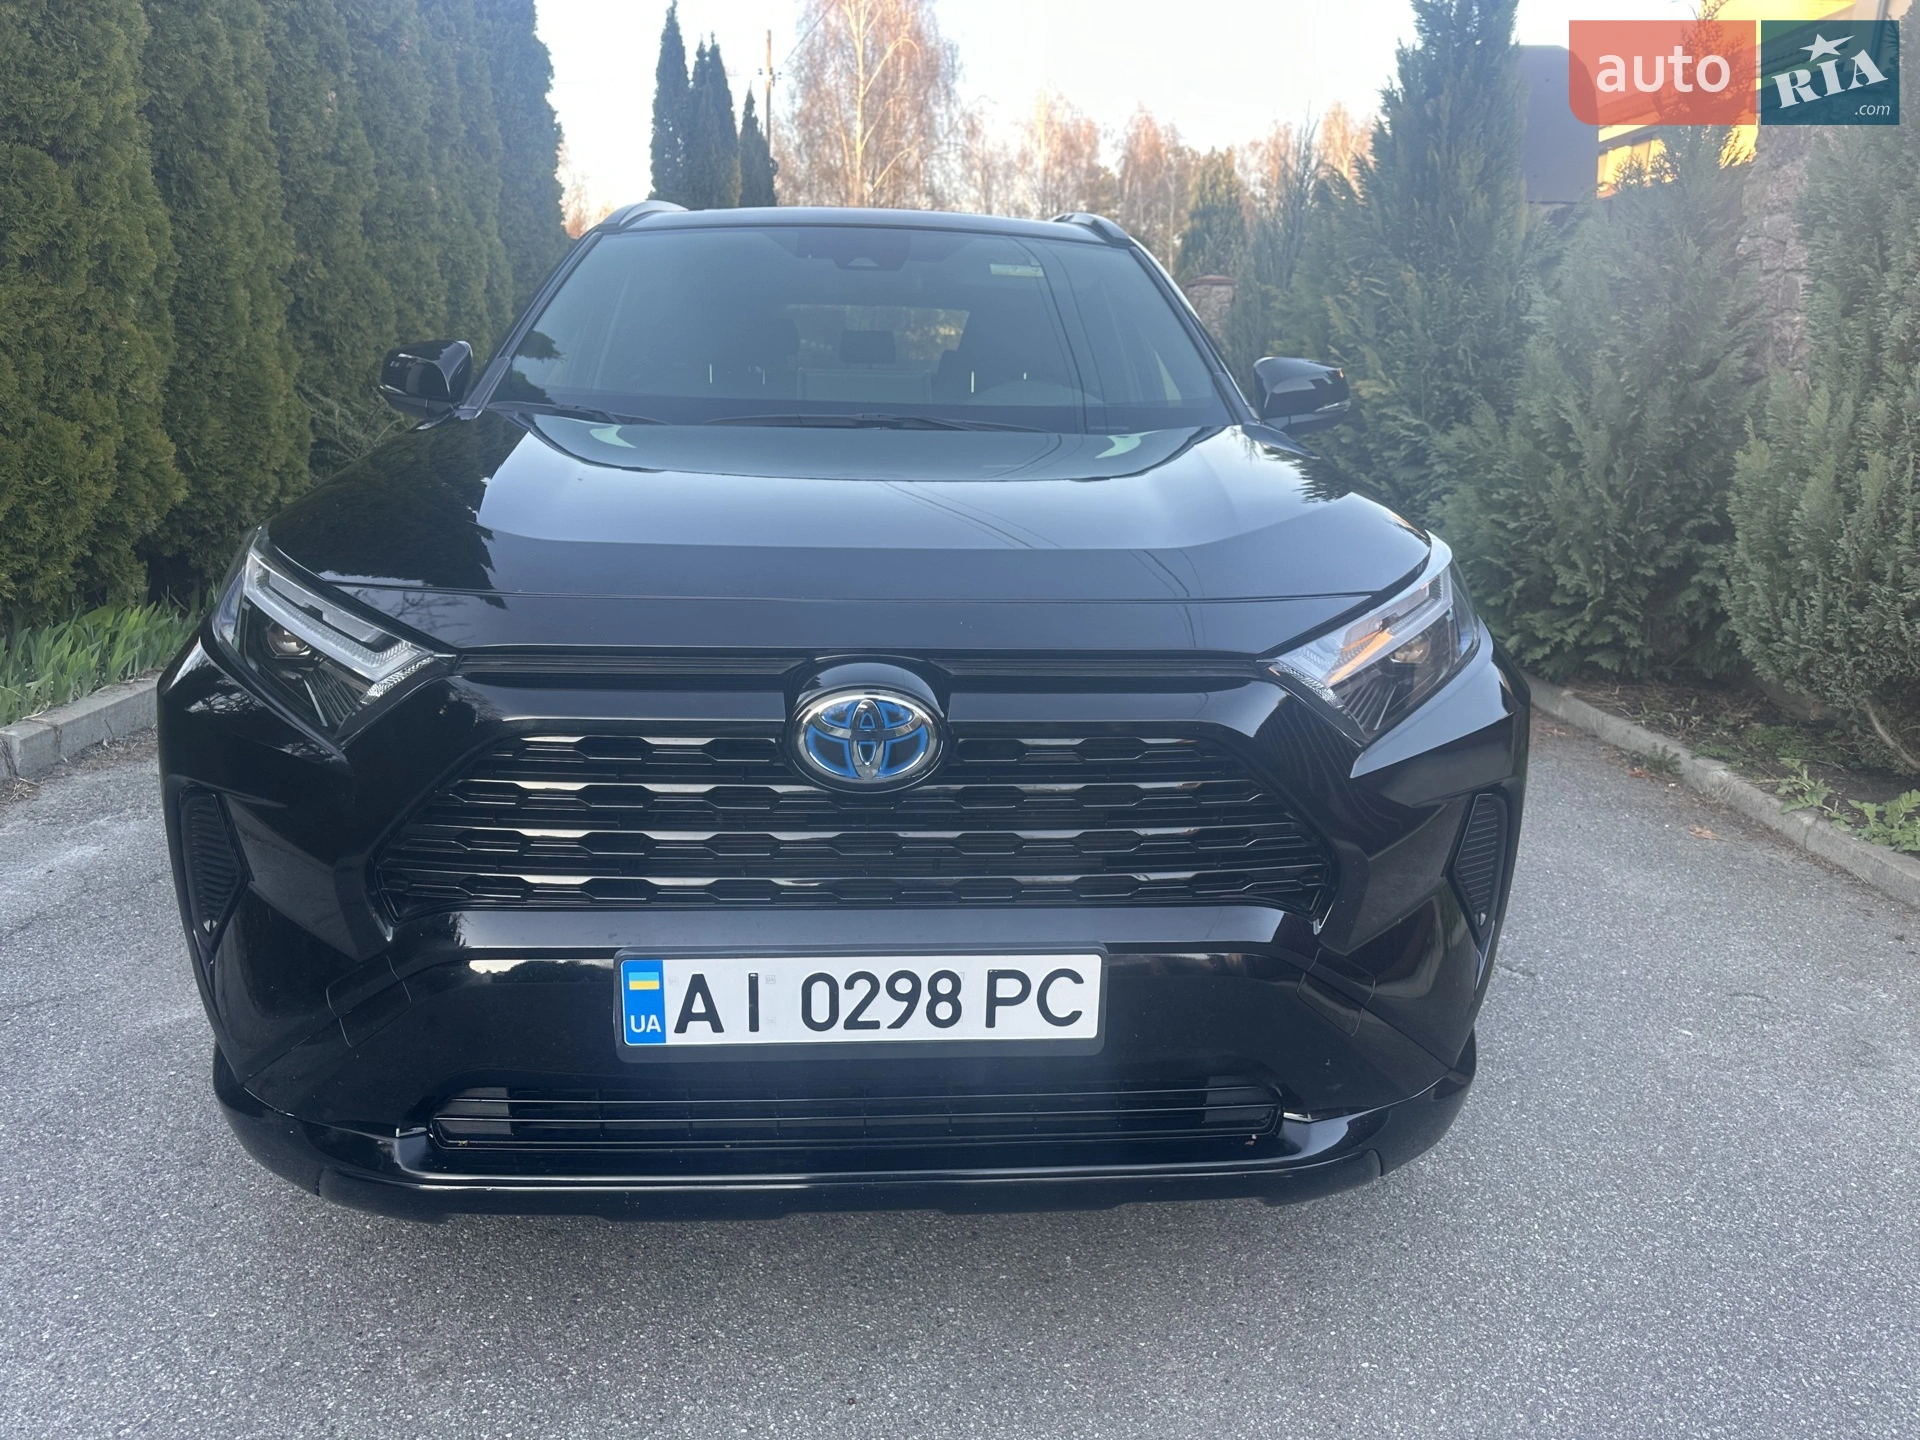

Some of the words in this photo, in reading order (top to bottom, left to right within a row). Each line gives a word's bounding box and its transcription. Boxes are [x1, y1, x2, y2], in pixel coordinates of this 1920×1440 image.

[801, 970, 962, 1031] 0298
[985, 968, 1084, 1028] PC
[630, 1014, 662, 1033] UA
